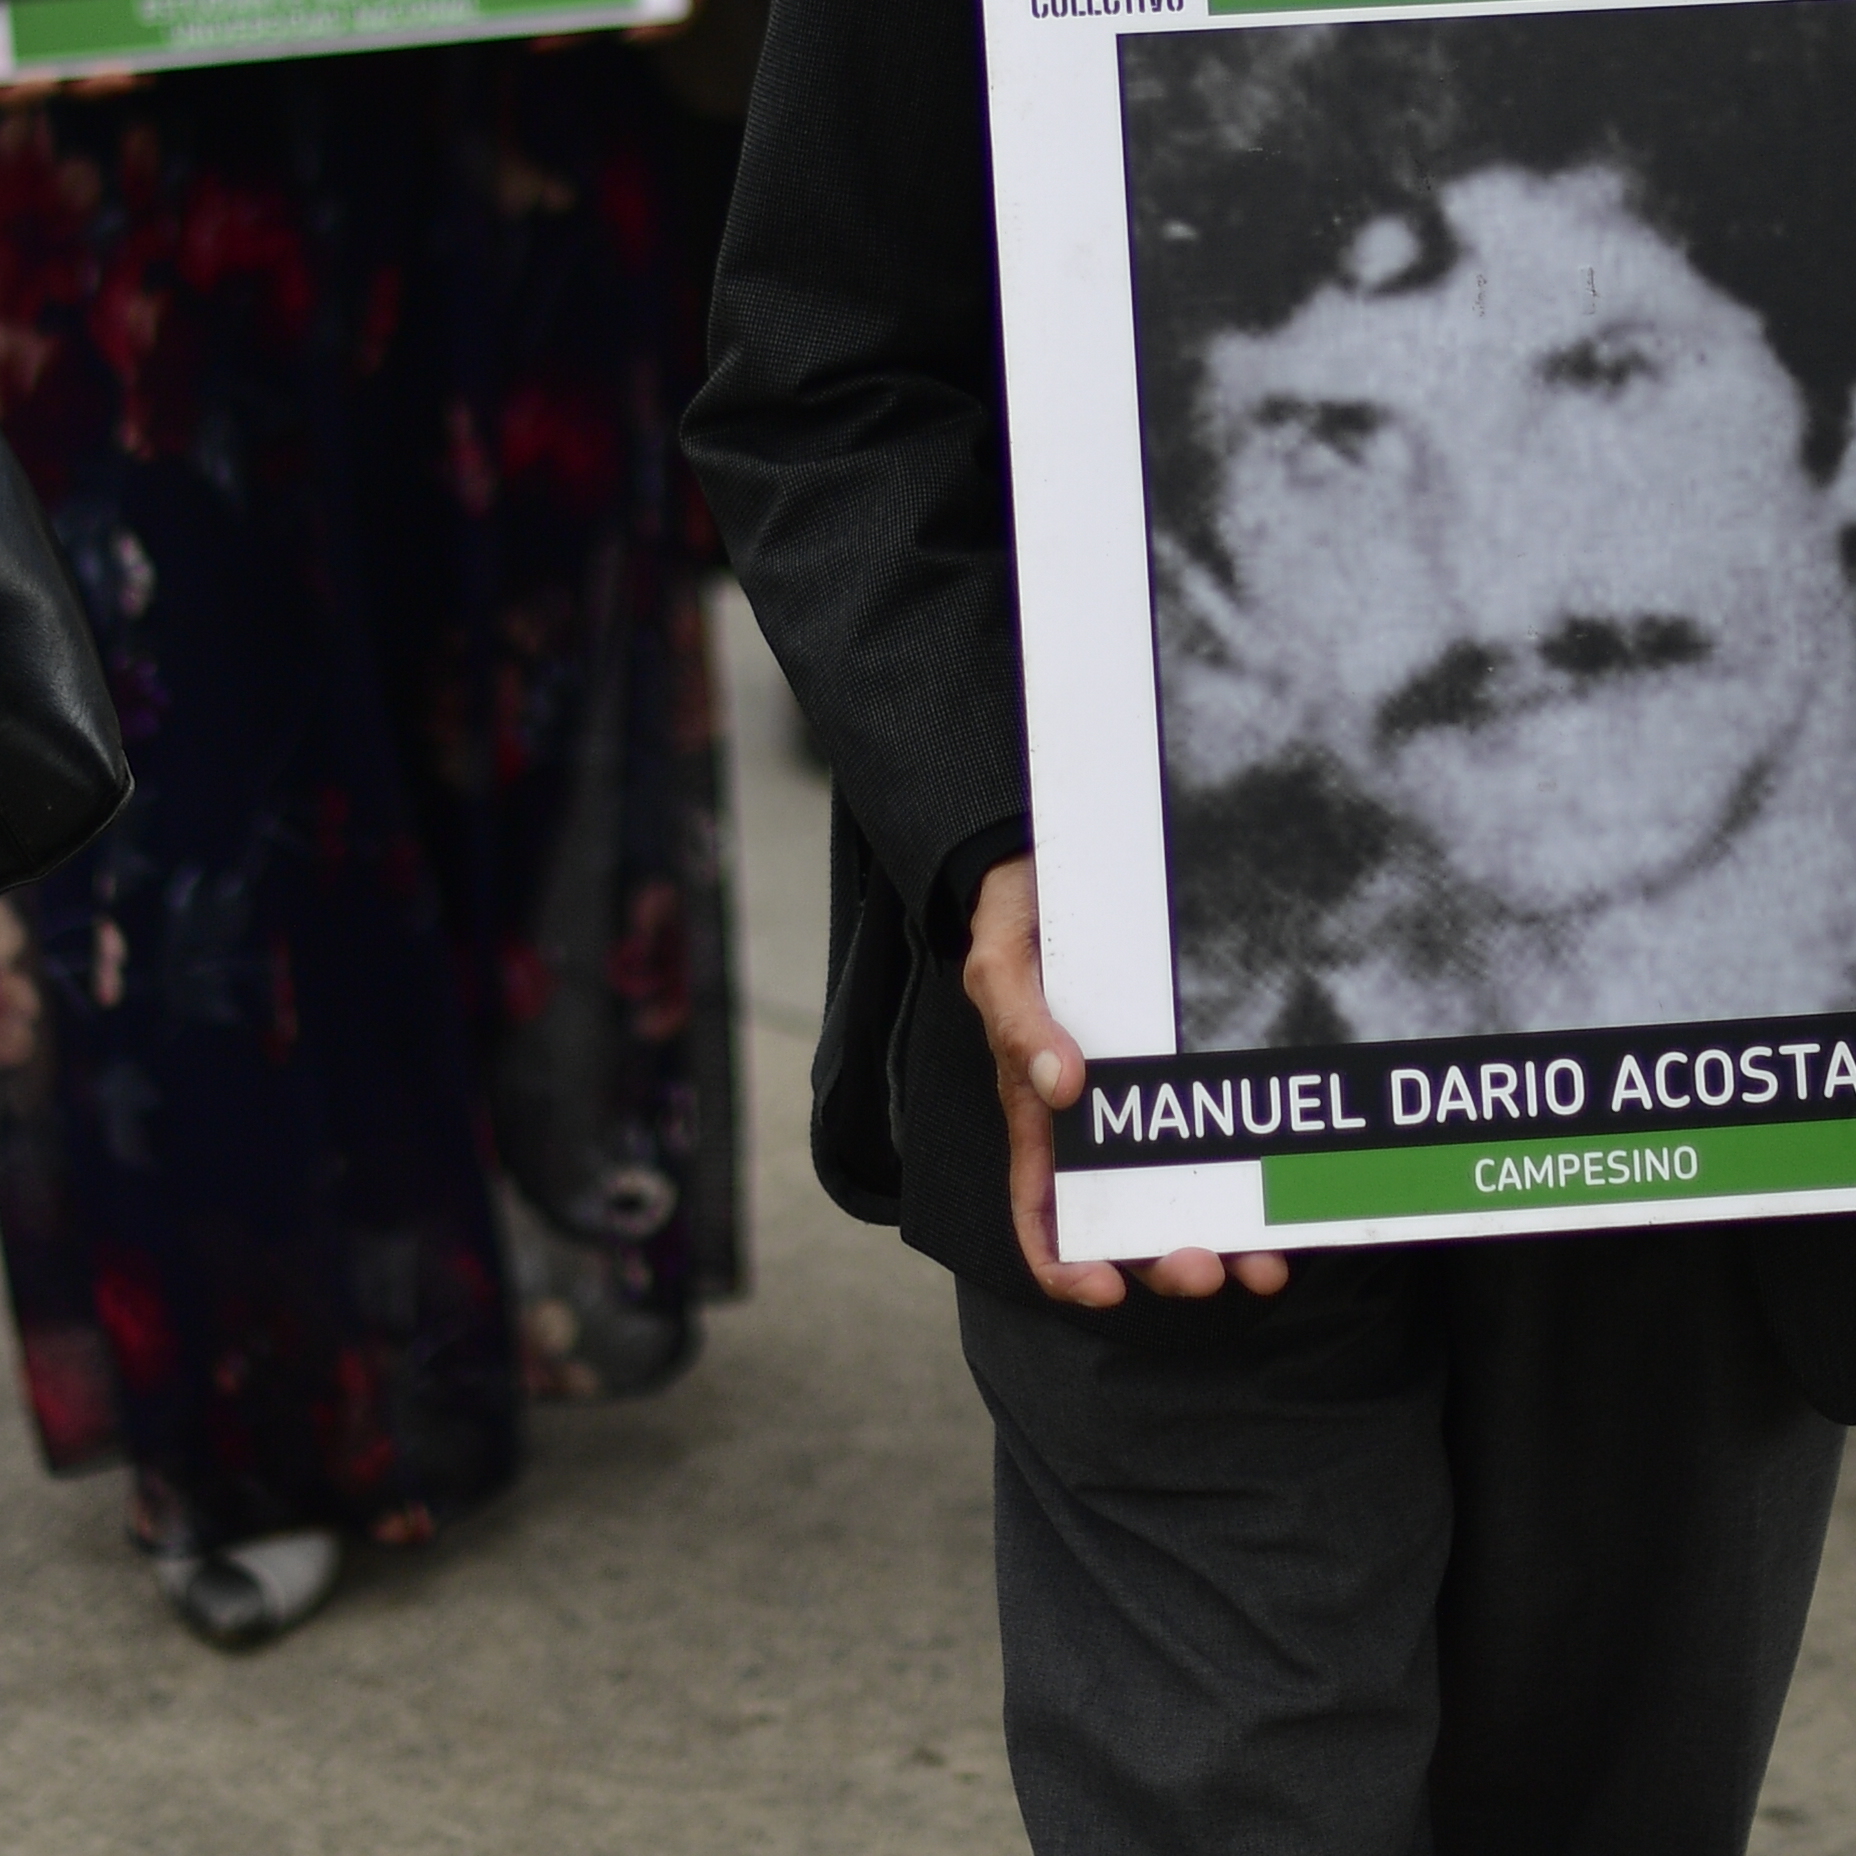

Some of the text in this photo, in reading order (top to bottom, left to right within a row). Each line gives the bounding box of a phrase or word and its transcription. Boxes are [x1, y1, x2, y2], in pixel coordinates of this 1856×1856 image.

[1093, 1072, 1366, 1144] MANUEL
[1391, 1058, 1585, 1126] DARIO
[1474, 1146, 1698, 1193] CAMPESINO
